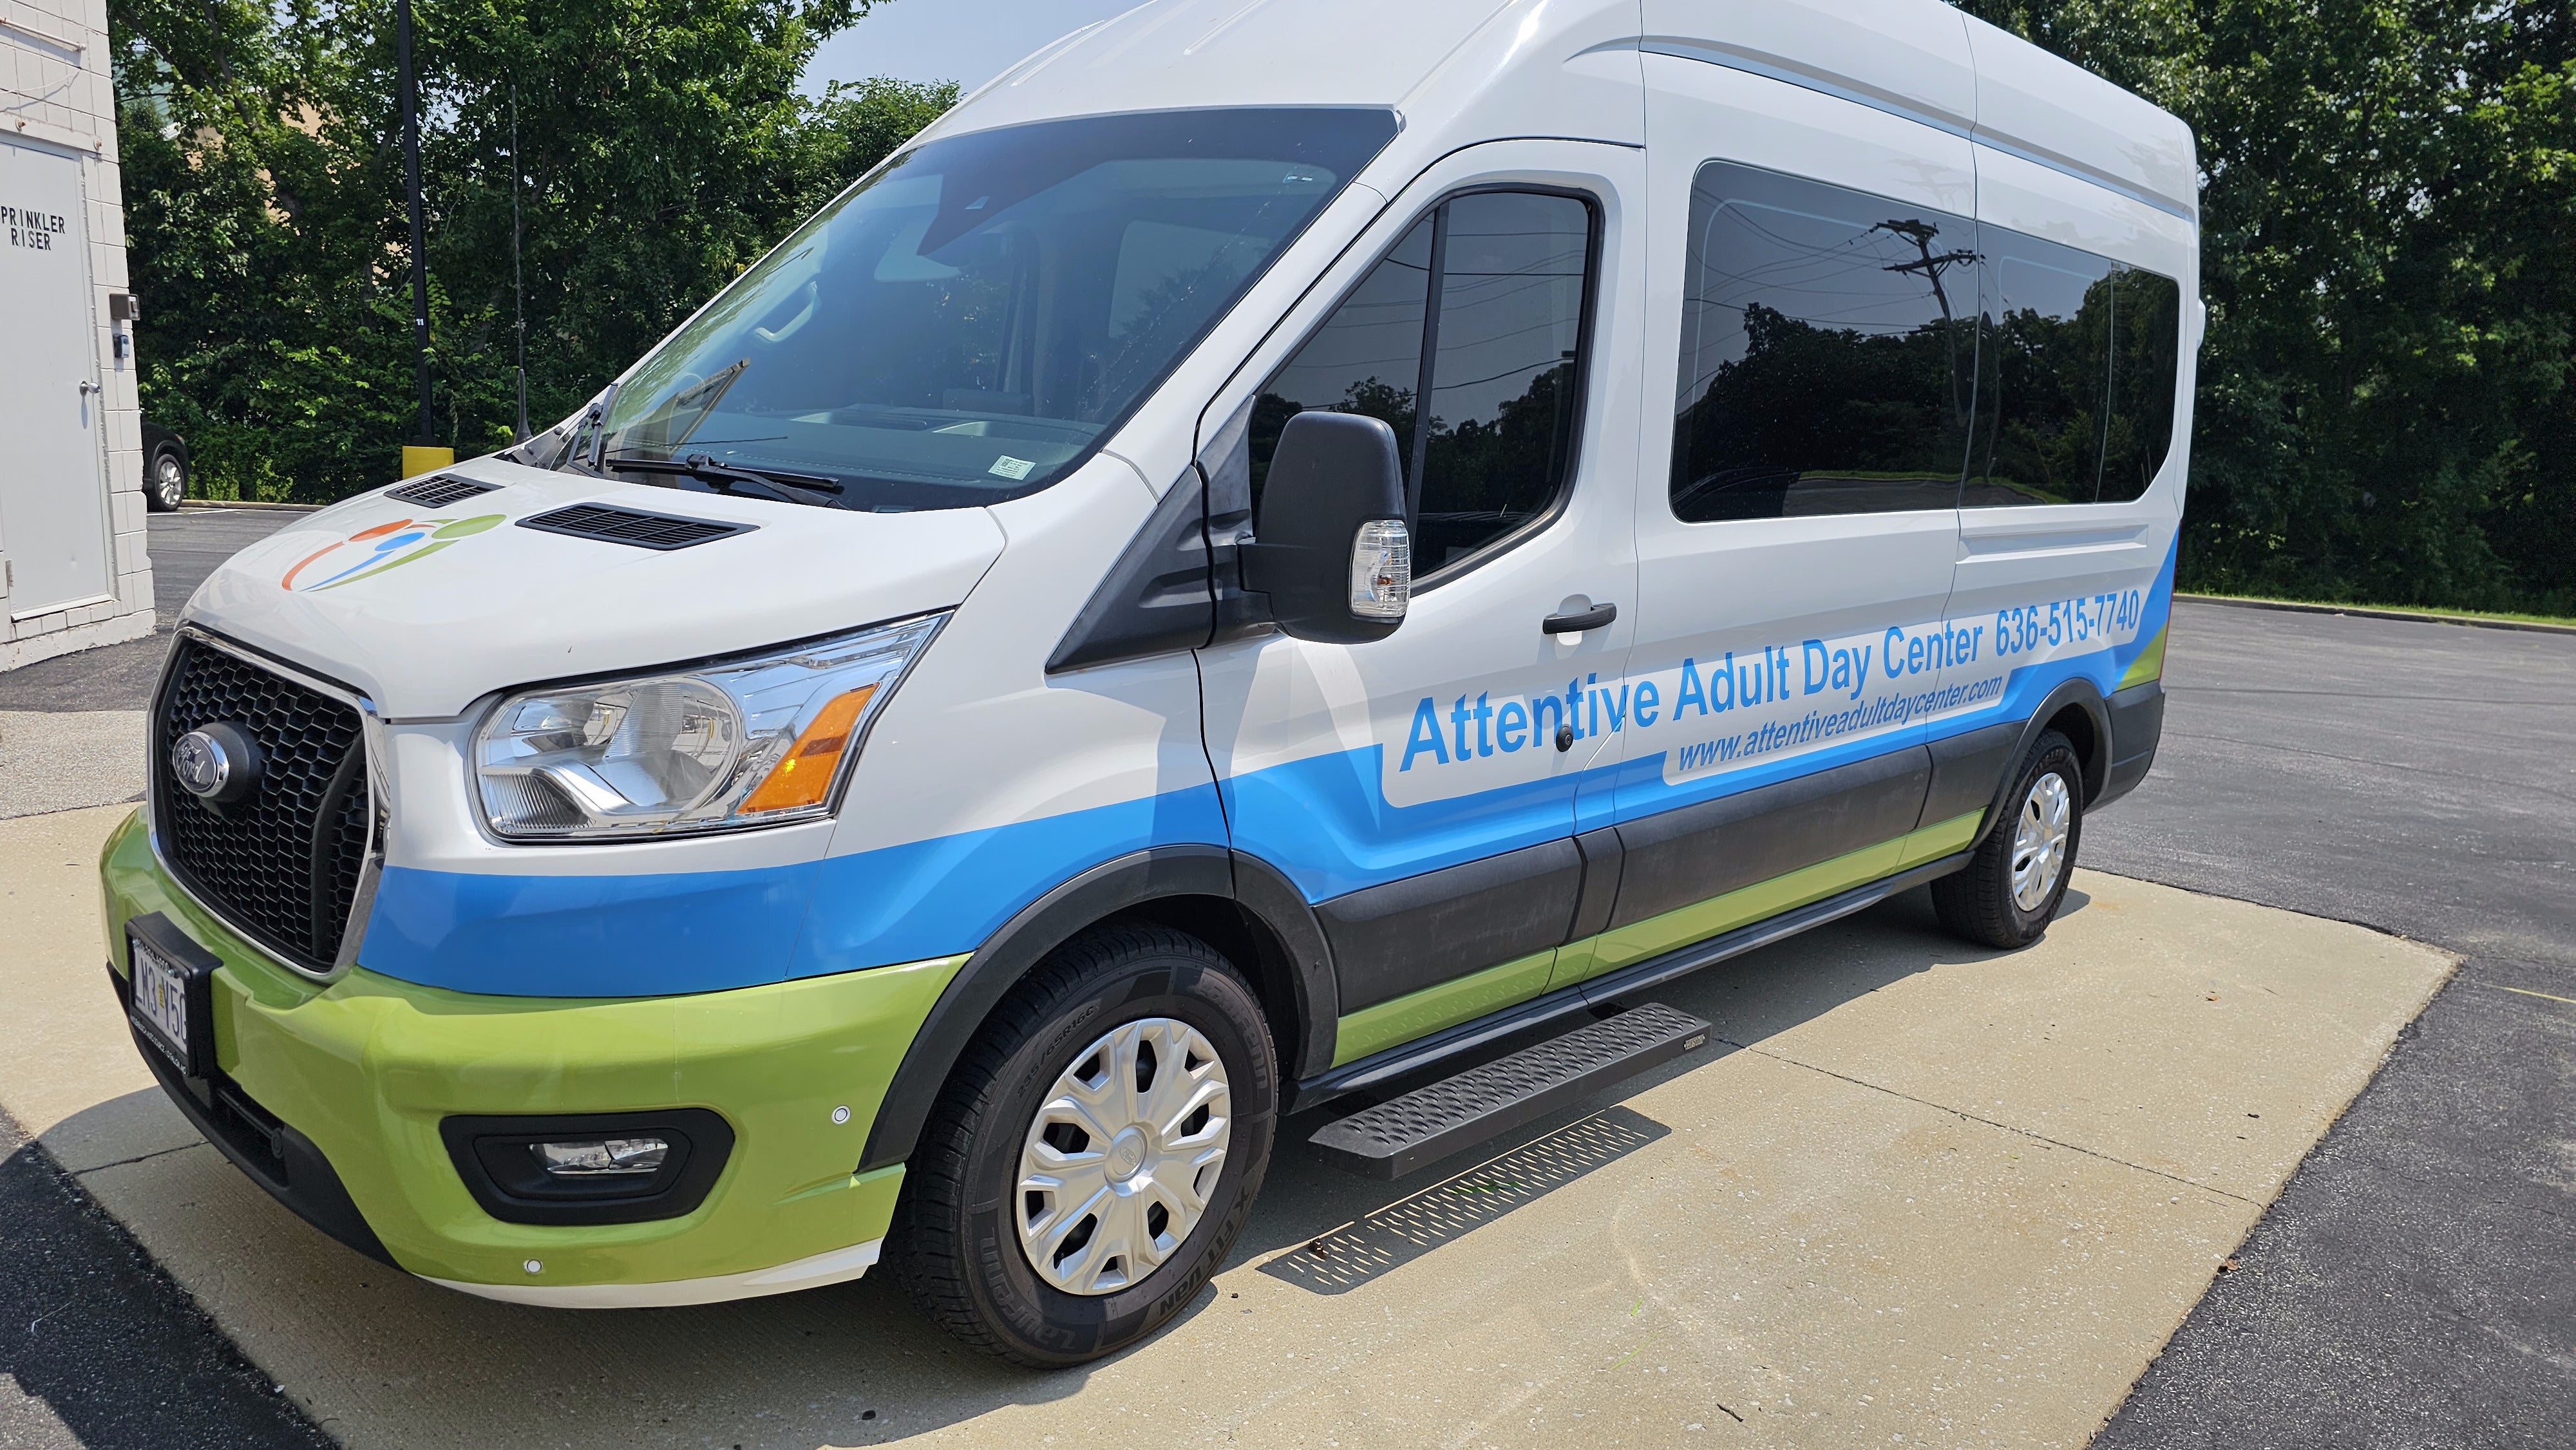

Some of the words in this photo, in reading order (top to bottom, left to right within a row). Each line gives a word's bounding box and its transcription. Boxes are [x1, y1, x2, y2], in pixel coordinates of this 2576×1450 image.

[1, 206, 65, 234] PRINKLER
[11, 227, 52, 250] RISER
[1399, 673, 1659, 772] Attentive
[1673, 645, 1790, 720] Adult
[1803, 639, 1871, 700] Day
[1884, 619, 1983, 679] Center
[1996, 589, 2139, 656] 636-515-7740
[1679, 675, 2002, 771] www.attentiveadultdaycenter.com
[177, 741, 205, 783] Ford
